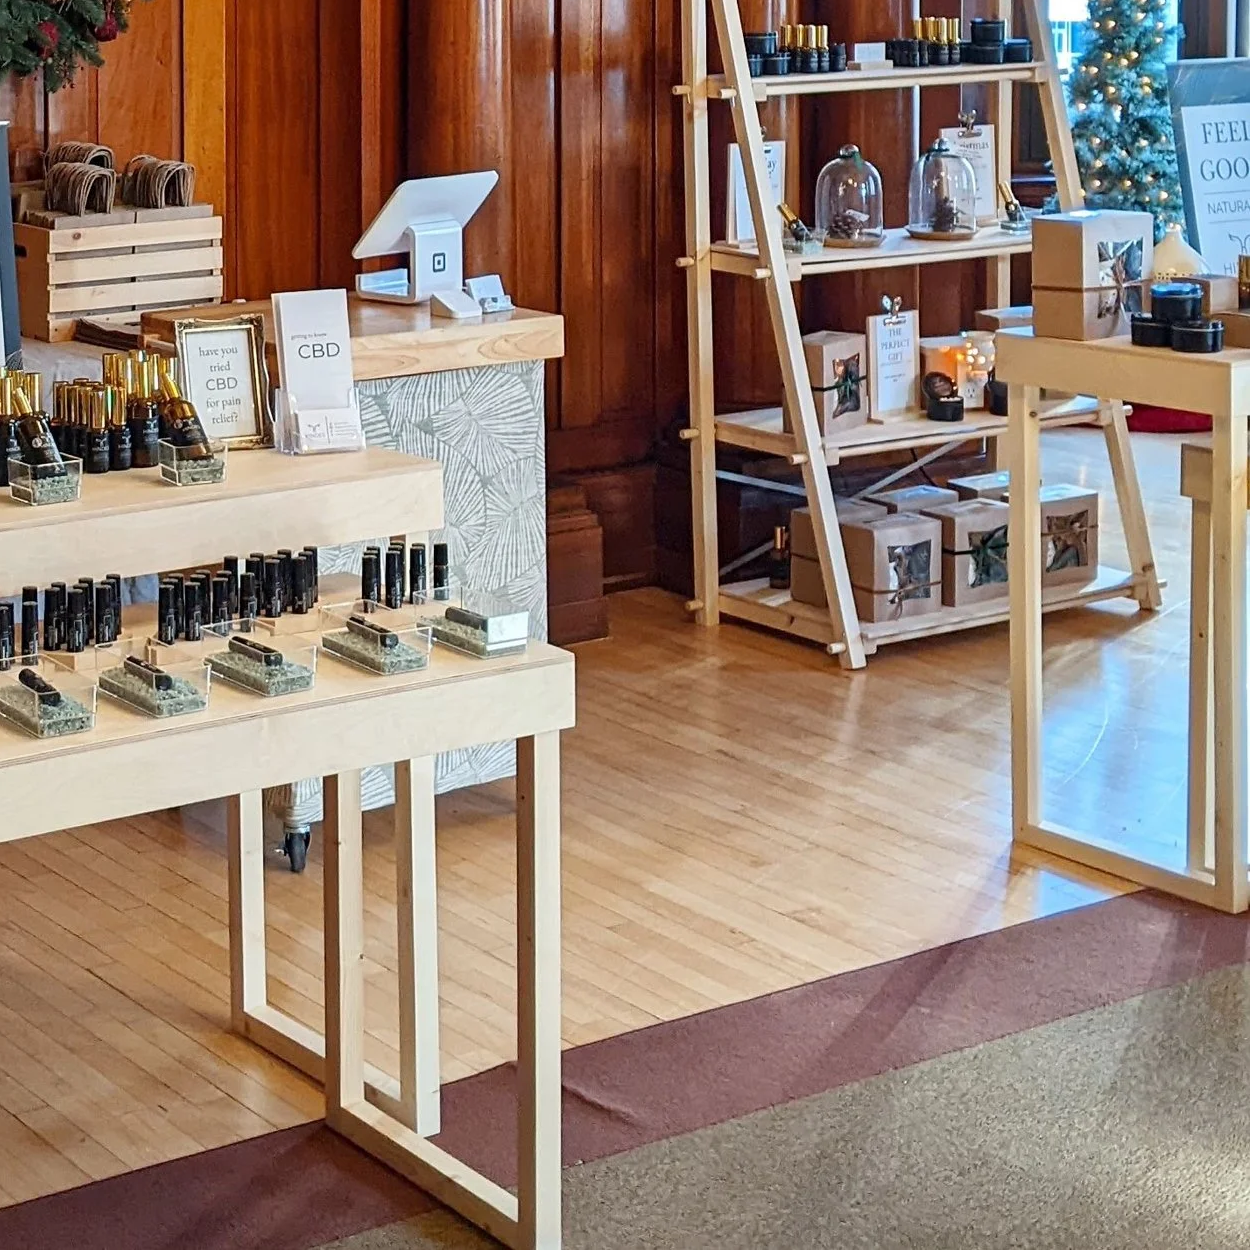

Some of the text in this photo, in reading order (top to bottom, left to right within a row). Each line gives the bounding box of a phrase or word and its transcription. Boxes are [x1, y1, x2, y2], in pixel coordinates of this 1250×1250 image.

[1201, 120, 1250, 145] FEEL
[1200, 157, 1250, 182] GOO
[1207, 200, 1250, 215] NATURA
[198, 347, 238, 358] have you
[298, 342, 341, 359] CBD
[209, 361, 231, 372] tried
[205, 377, 238, 391] CBD
[206, 397, 241, 410] for pain
[212, 412, 238, 424] relief?
